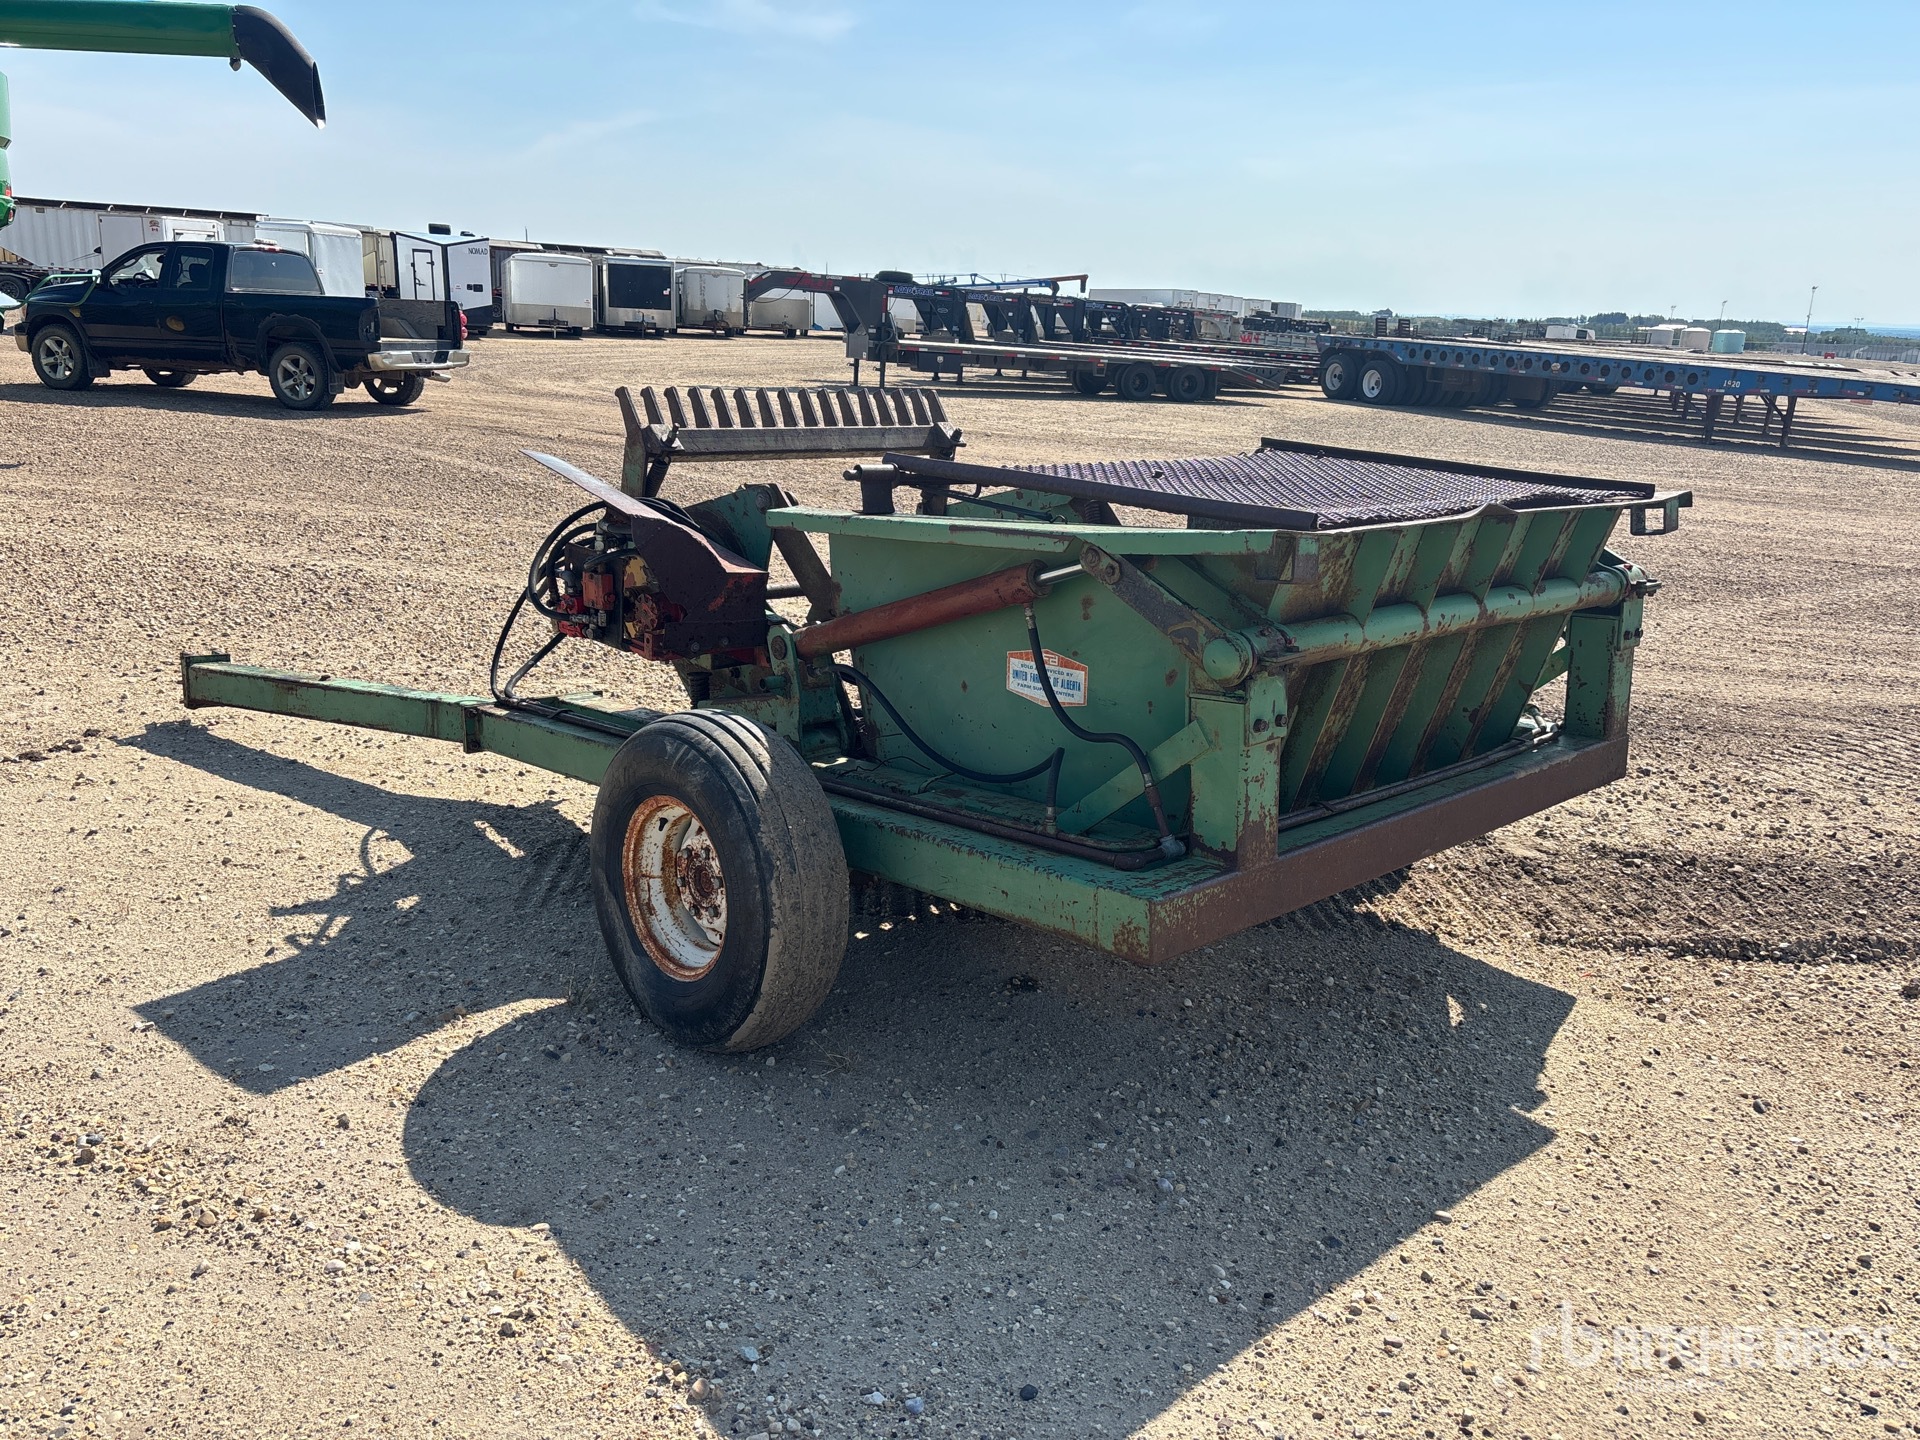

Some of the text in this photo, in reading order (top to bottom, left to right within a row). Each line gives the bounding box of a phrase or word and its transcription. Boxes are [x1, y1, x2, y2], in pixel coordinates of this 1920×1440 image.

[467, 247, 489, 255] NOMAD
[1723, 379, 1741, 388] 1920
[1012, 669, 1028, 681] UNITED
[1053, 677, 1060, 688] OF
[1061, 679, 1081, 691] ALBERTA
[1055, 690, 1075, 698] ENTERS
